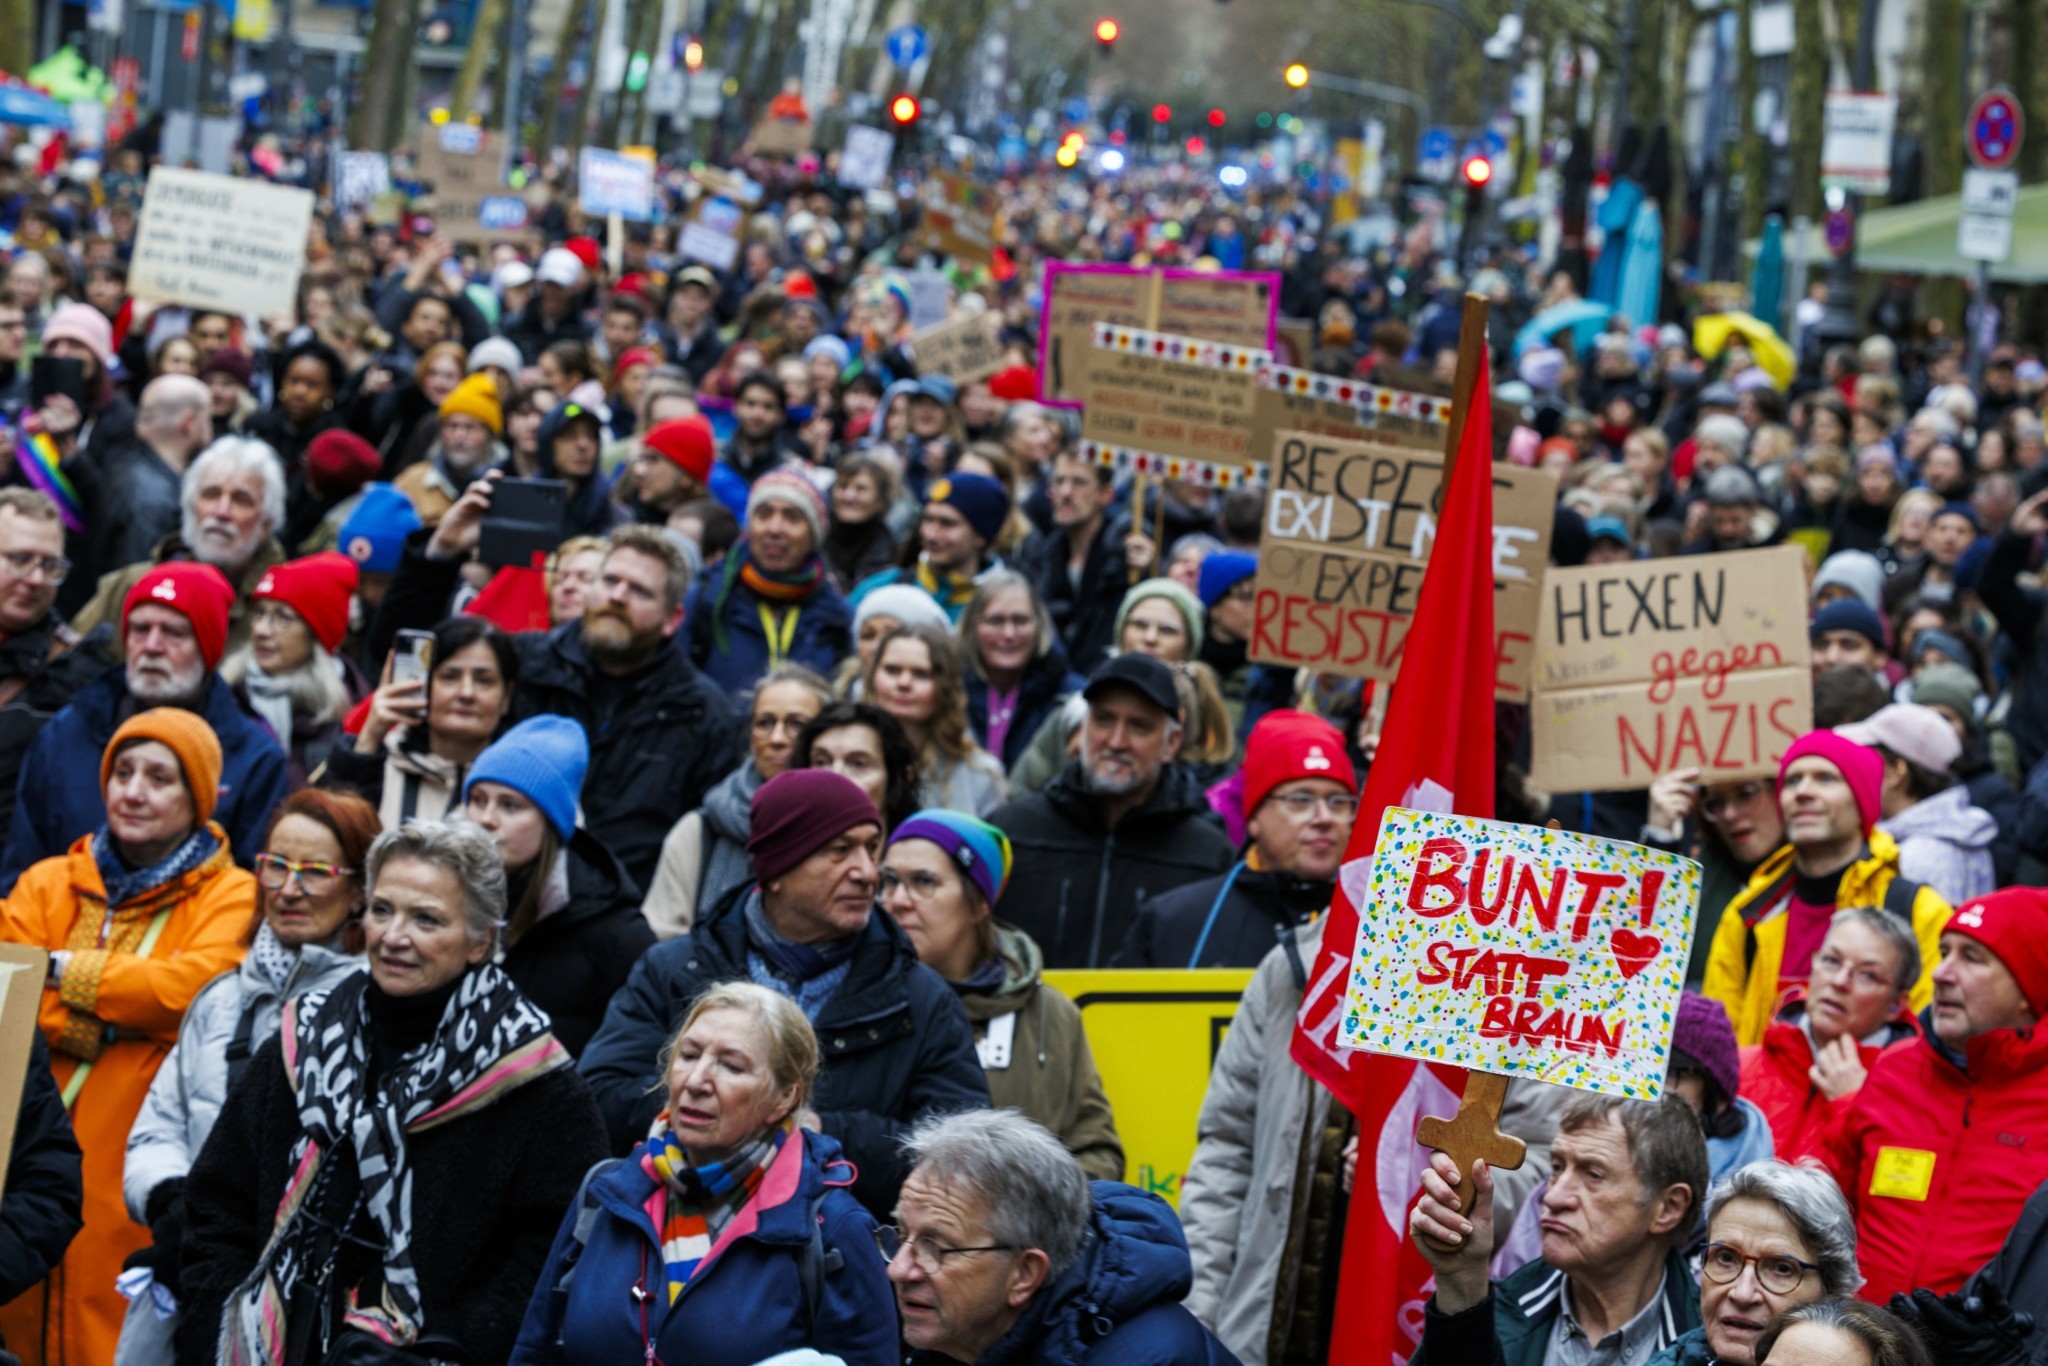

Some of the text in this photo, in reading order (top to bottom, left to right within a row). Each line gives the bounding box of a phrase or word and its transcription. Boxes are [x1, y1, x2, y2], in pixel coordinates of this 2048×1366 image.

[1279, 439, 1514, 550] RESPE
[1554, 569, 1725, 645] HEXEN
[1648, 642, 1782, 704] gegen
[1407, 837, 1666, 943] BUNT!
[1416, 941, 1570, 998] STATT
[1479, 996, 1627, 1059] BRAUN
